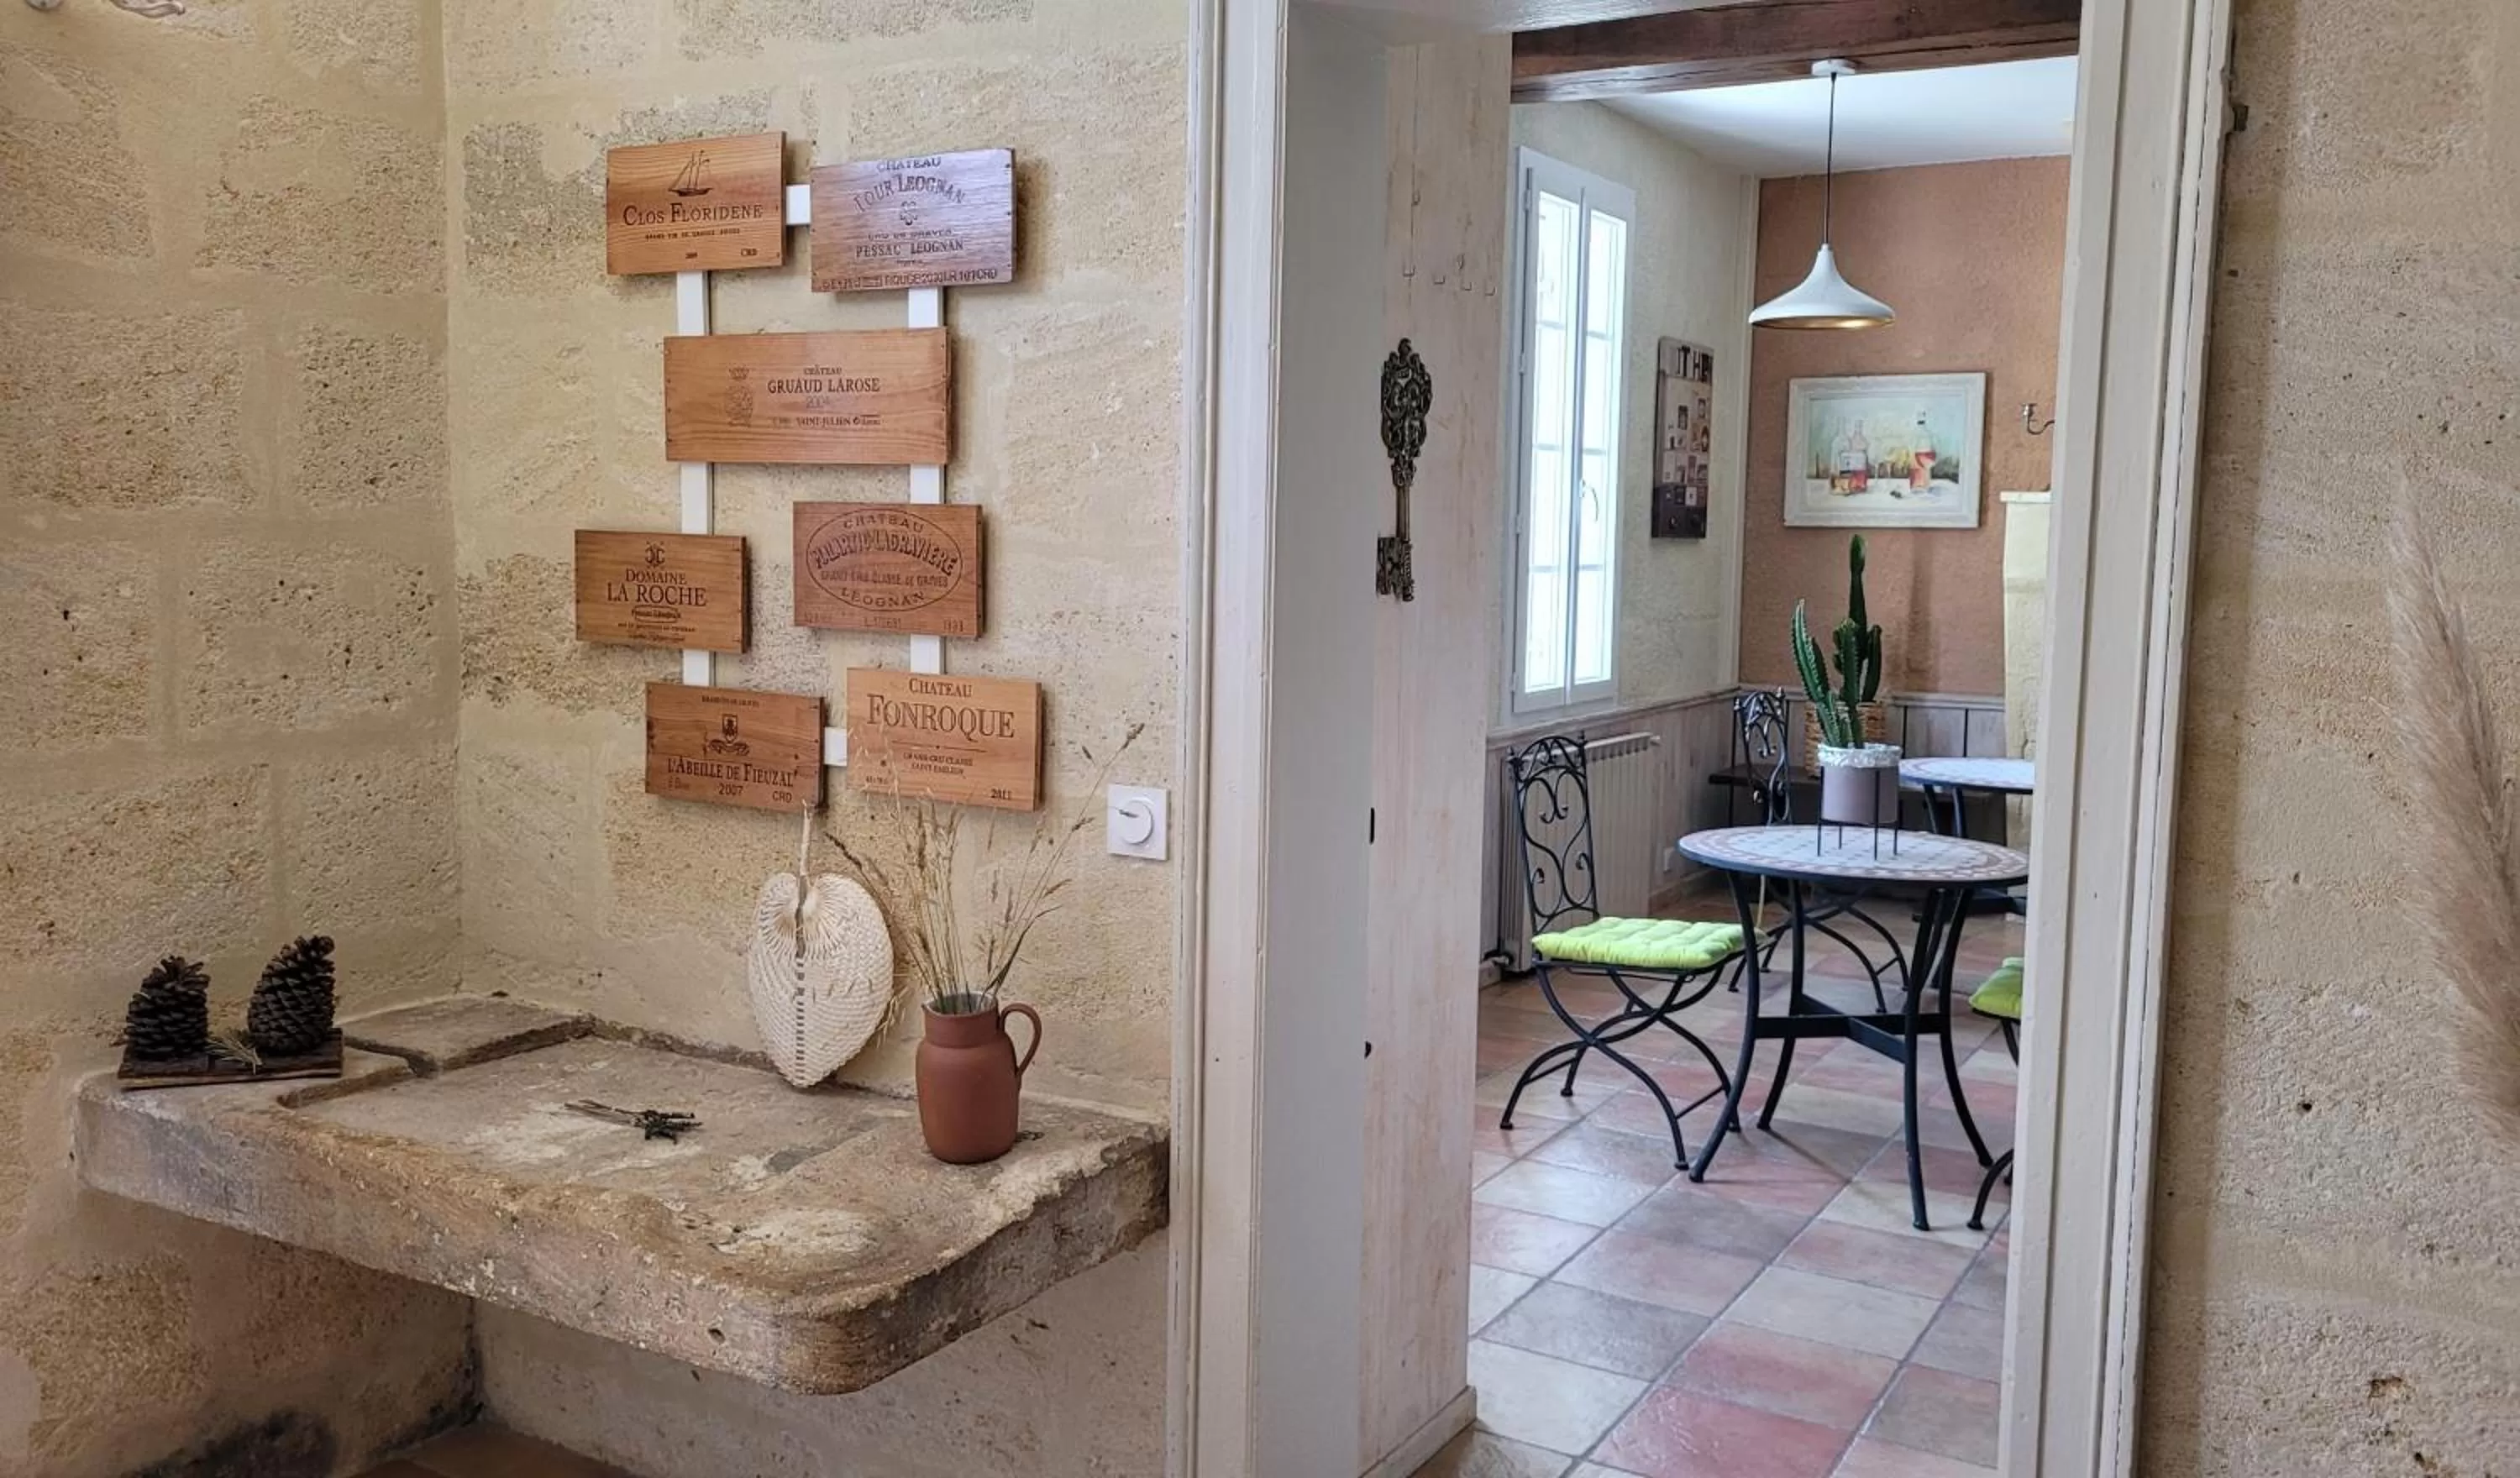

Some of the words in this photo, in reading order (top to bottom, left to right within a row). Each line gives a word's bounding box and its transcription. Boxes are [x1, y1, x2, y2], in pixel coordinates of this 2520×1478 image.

[767, 379, 823, 395] GRUAUD
[827, 377, 881, 393] LAROSE
[843, 513, 924, 533] CHATEAU
[607, 582, 629, 602] LA
[637, 584, 707, 607] ROCHE
[718, 782, 743, 796] 2007
